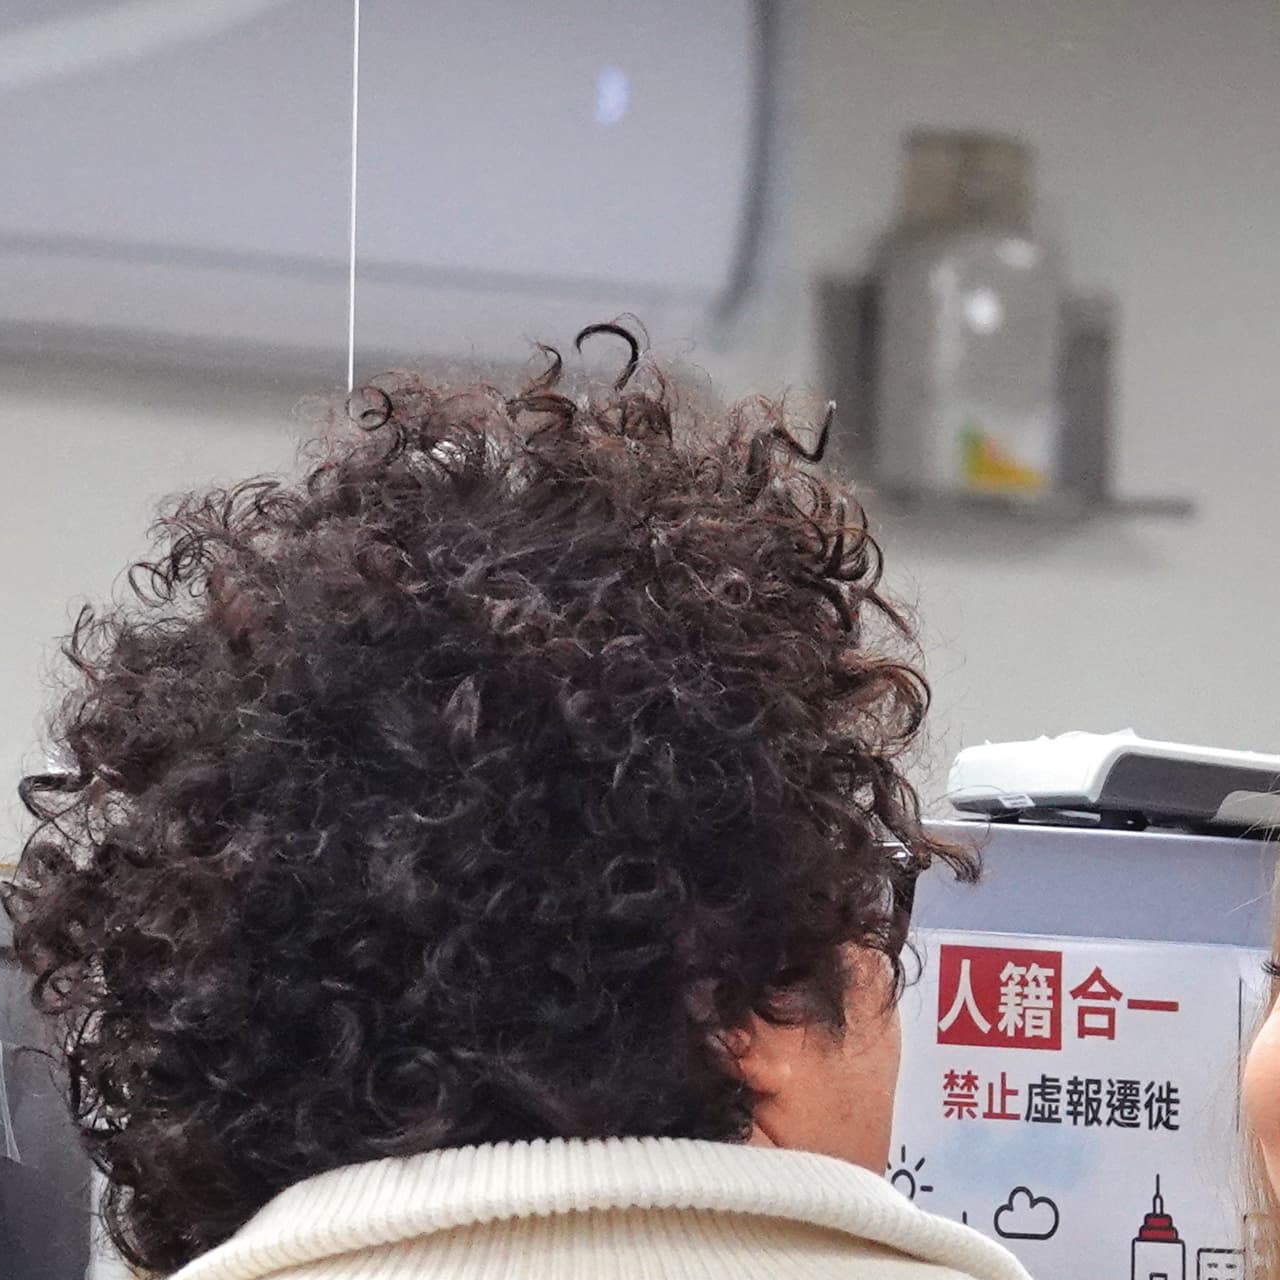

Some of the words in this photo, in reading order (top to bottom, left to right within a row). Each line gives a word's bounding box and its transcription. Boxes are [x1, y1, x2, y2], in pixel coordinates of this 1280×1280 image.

[937, 958, 1180, 1041] 人籍合一
[942, 1069, 1181, 1131] 禁止虛報遷徙
